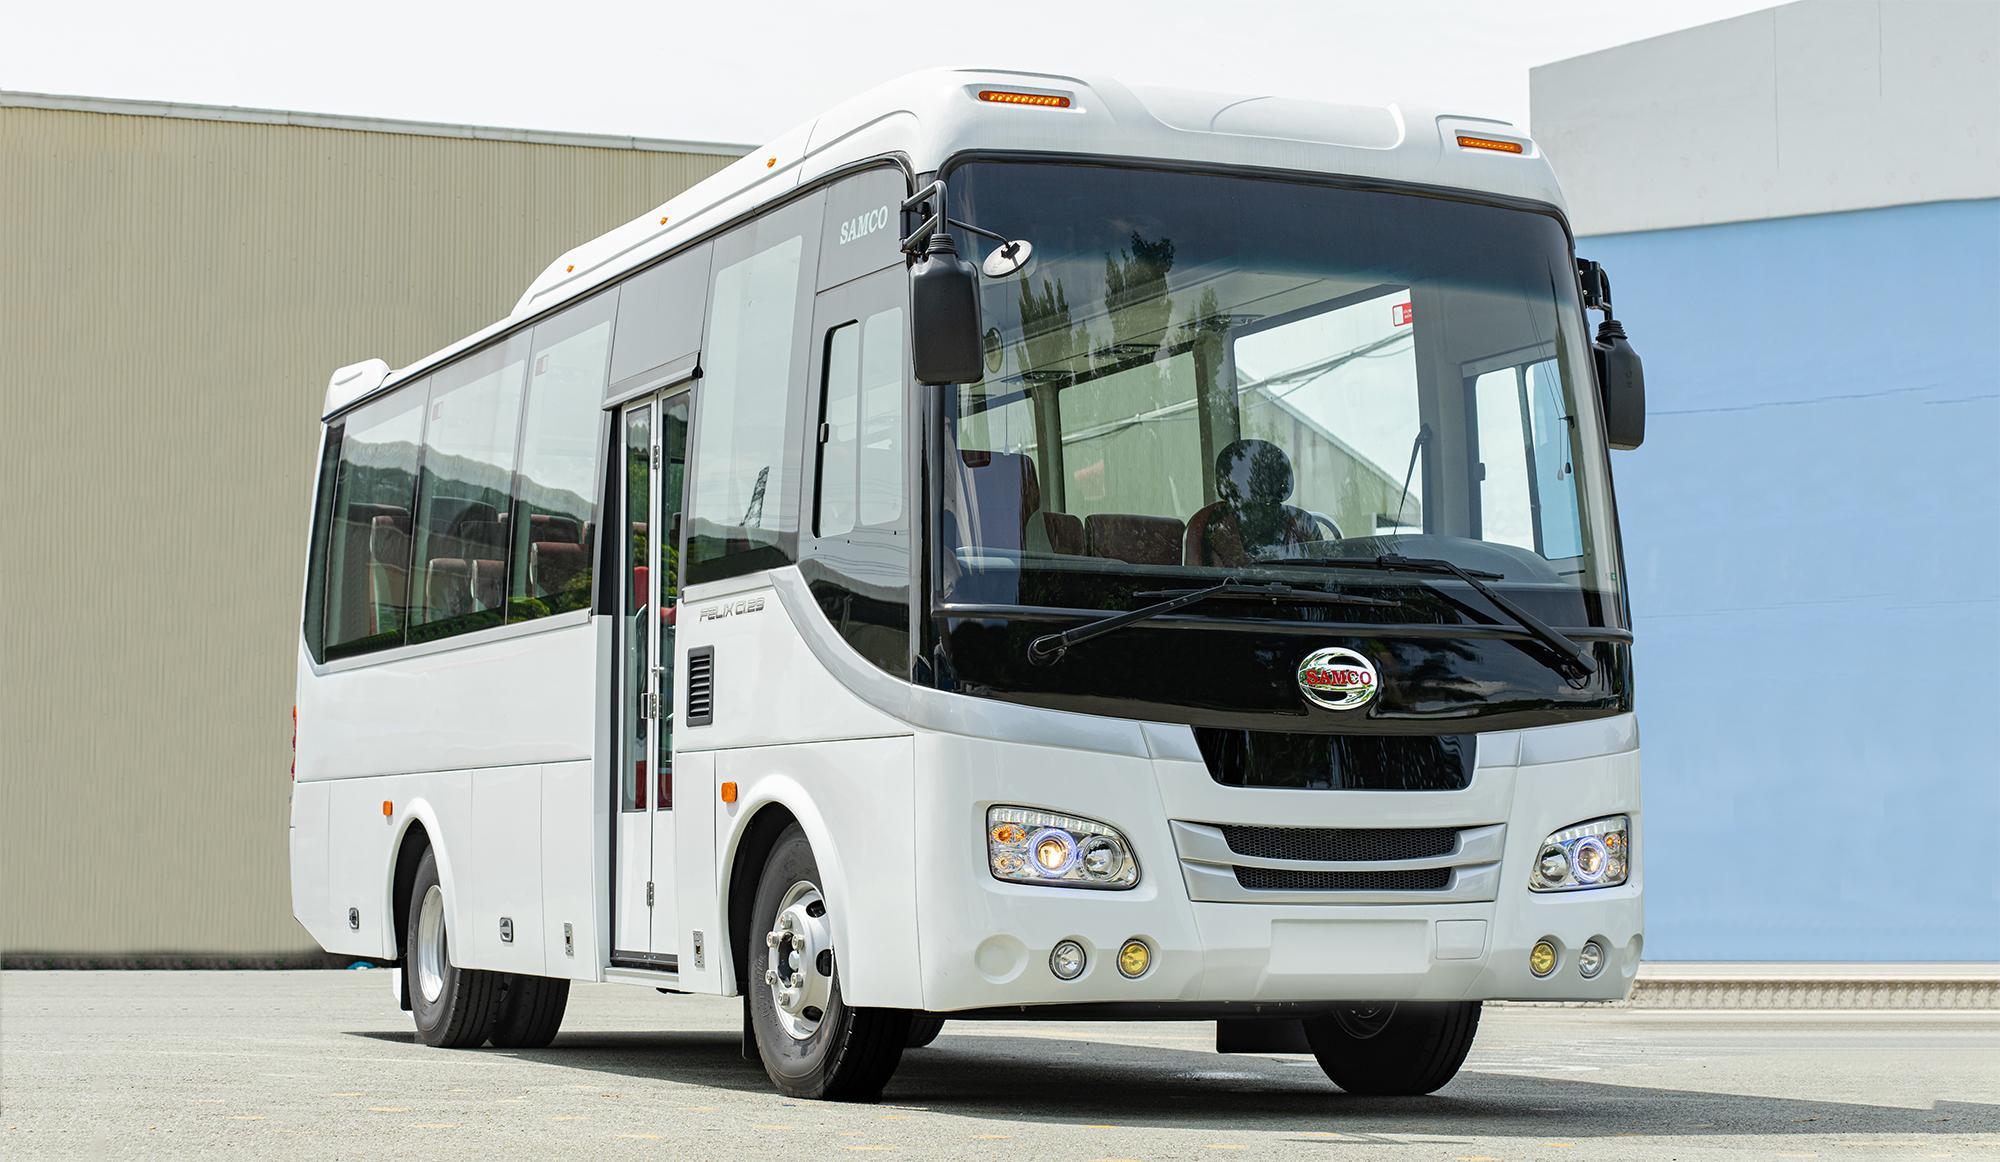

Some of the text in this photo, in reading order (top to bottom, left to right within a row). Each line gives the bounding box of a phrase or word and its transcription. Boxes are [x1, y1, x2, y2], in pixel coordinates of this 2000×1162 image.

[839, 205, 888, 245] SAMCO
[699, 602, 735, 622] FELIX
[1305, 669, 1372, 686] SAMCO
